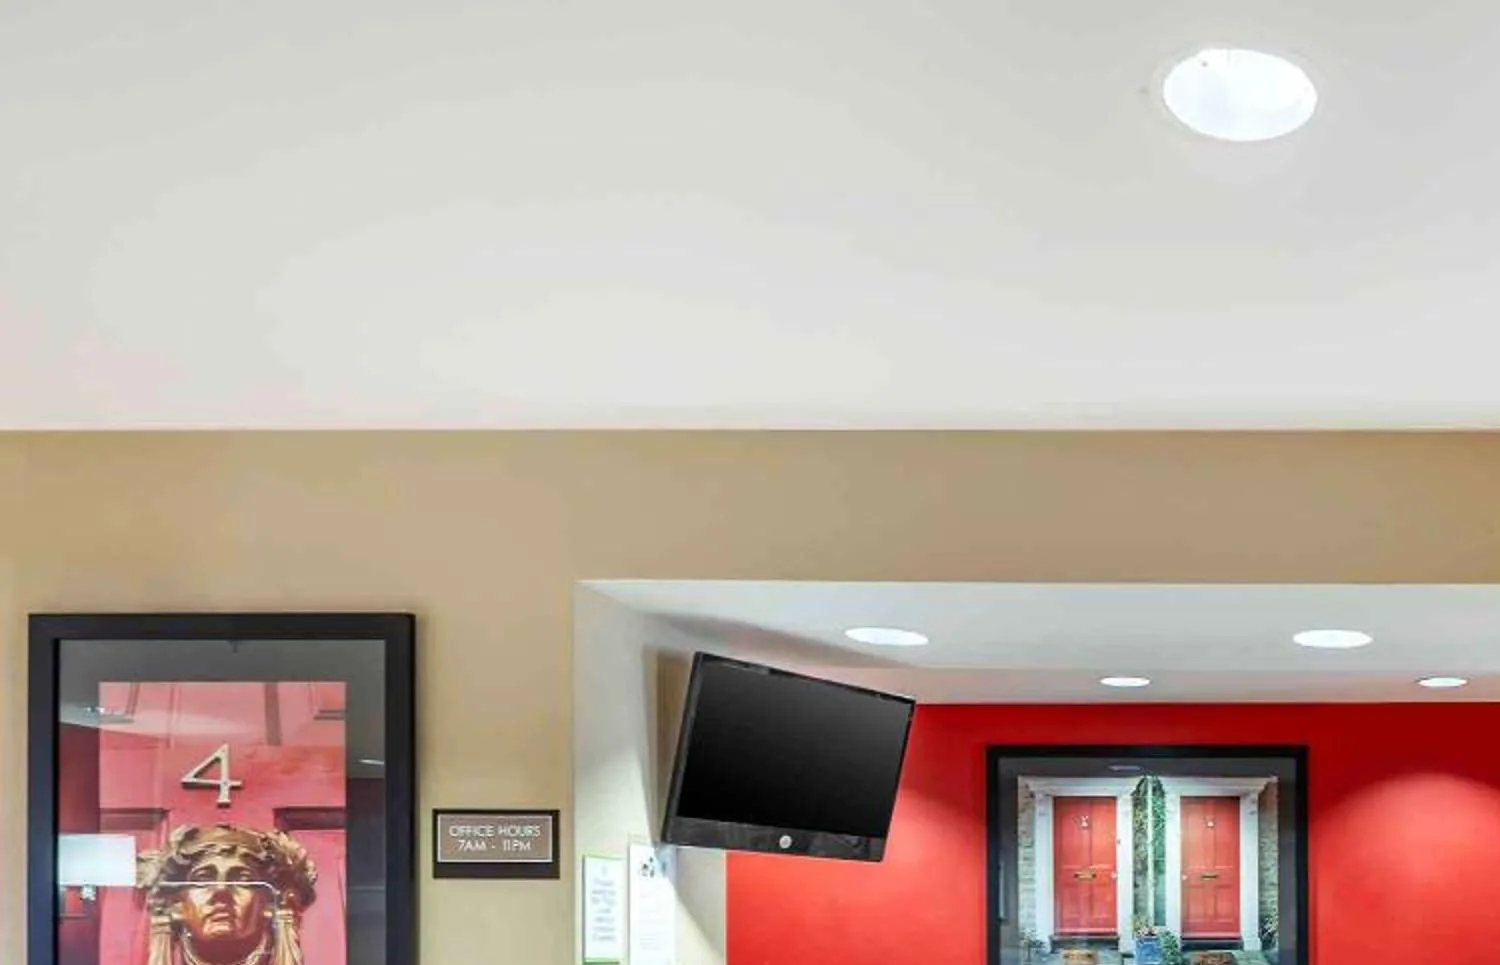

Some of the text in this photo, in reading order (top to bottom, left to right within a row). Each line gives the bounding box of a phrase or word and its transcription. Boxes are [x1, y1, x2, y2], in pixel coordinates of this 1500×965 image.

[181, 743, 242, 804] 4
[449, 825, 541, 837] OFFICE HOURS
[458, 839, 487, 851] 7AM
[503, 839, 531, 851] 11PM
